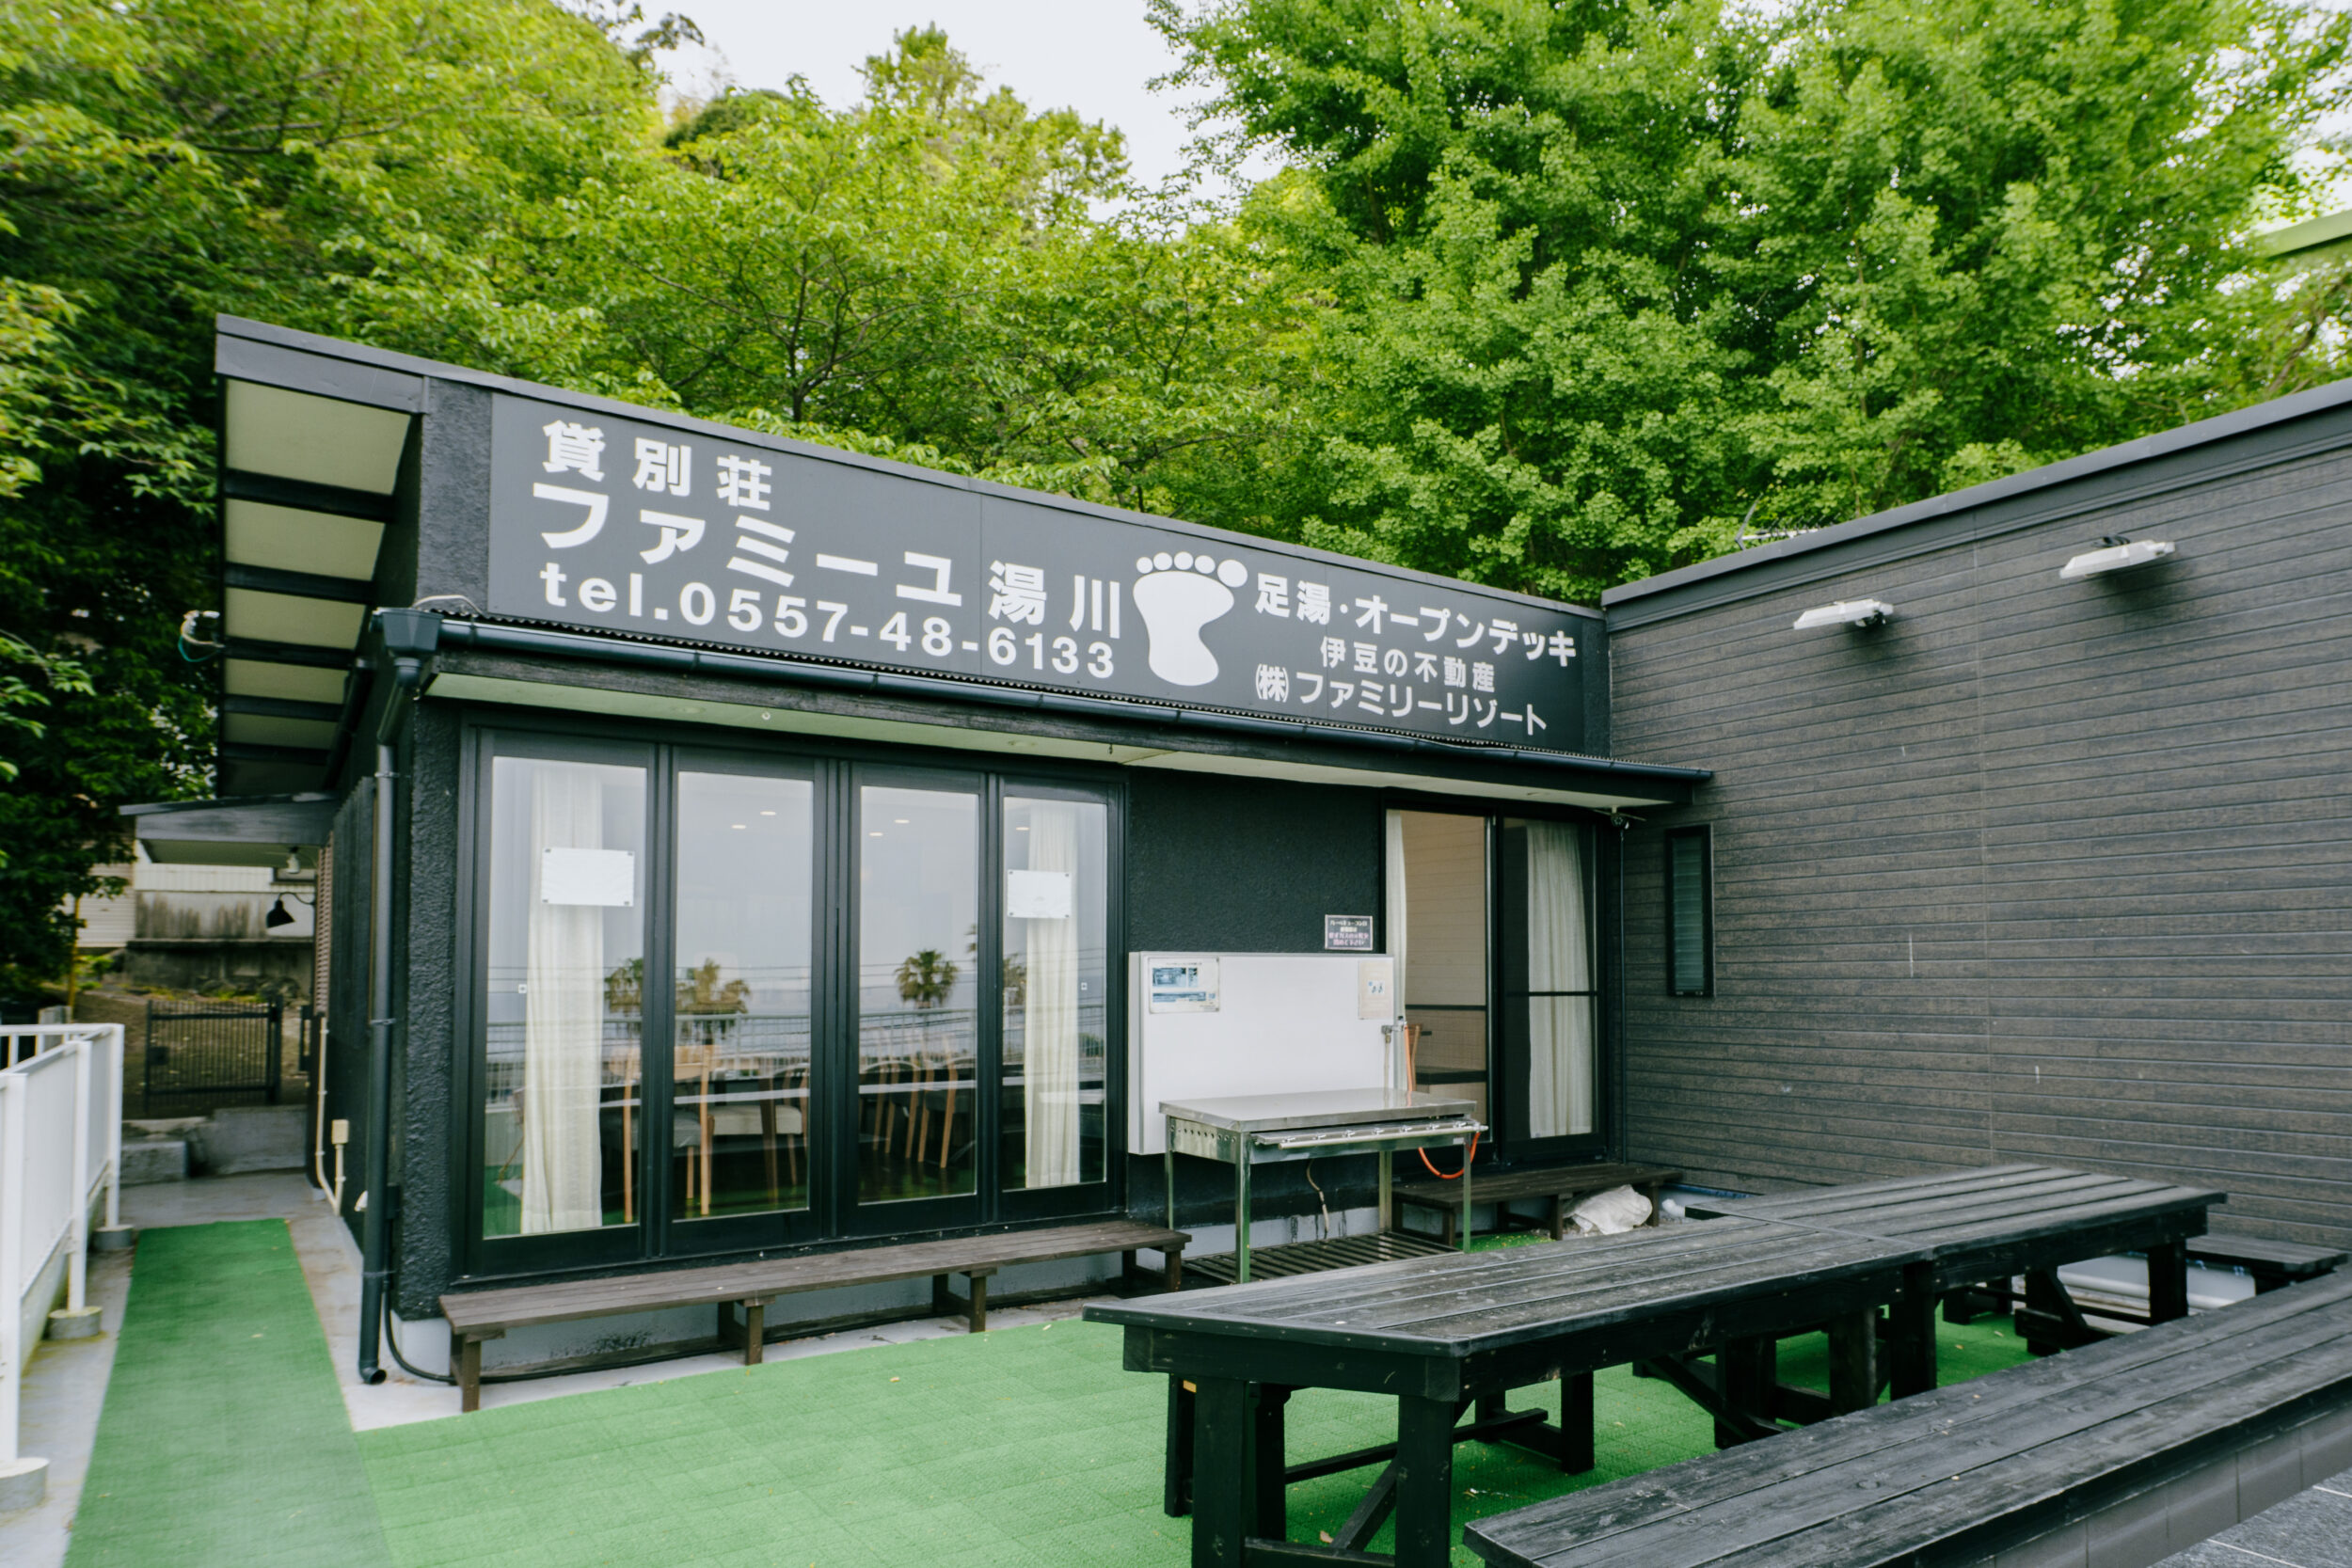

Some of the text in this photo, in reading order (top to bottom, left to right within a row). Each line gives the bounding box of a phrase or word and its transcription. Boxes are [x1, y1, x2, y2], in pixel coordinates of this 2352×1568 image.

[542, 420, 772, 512] 貸別荘
[539, 562, 1115, 679] tel.0557-48-6133
[1319, 635, 1495, 693] 伊豆の不動産
